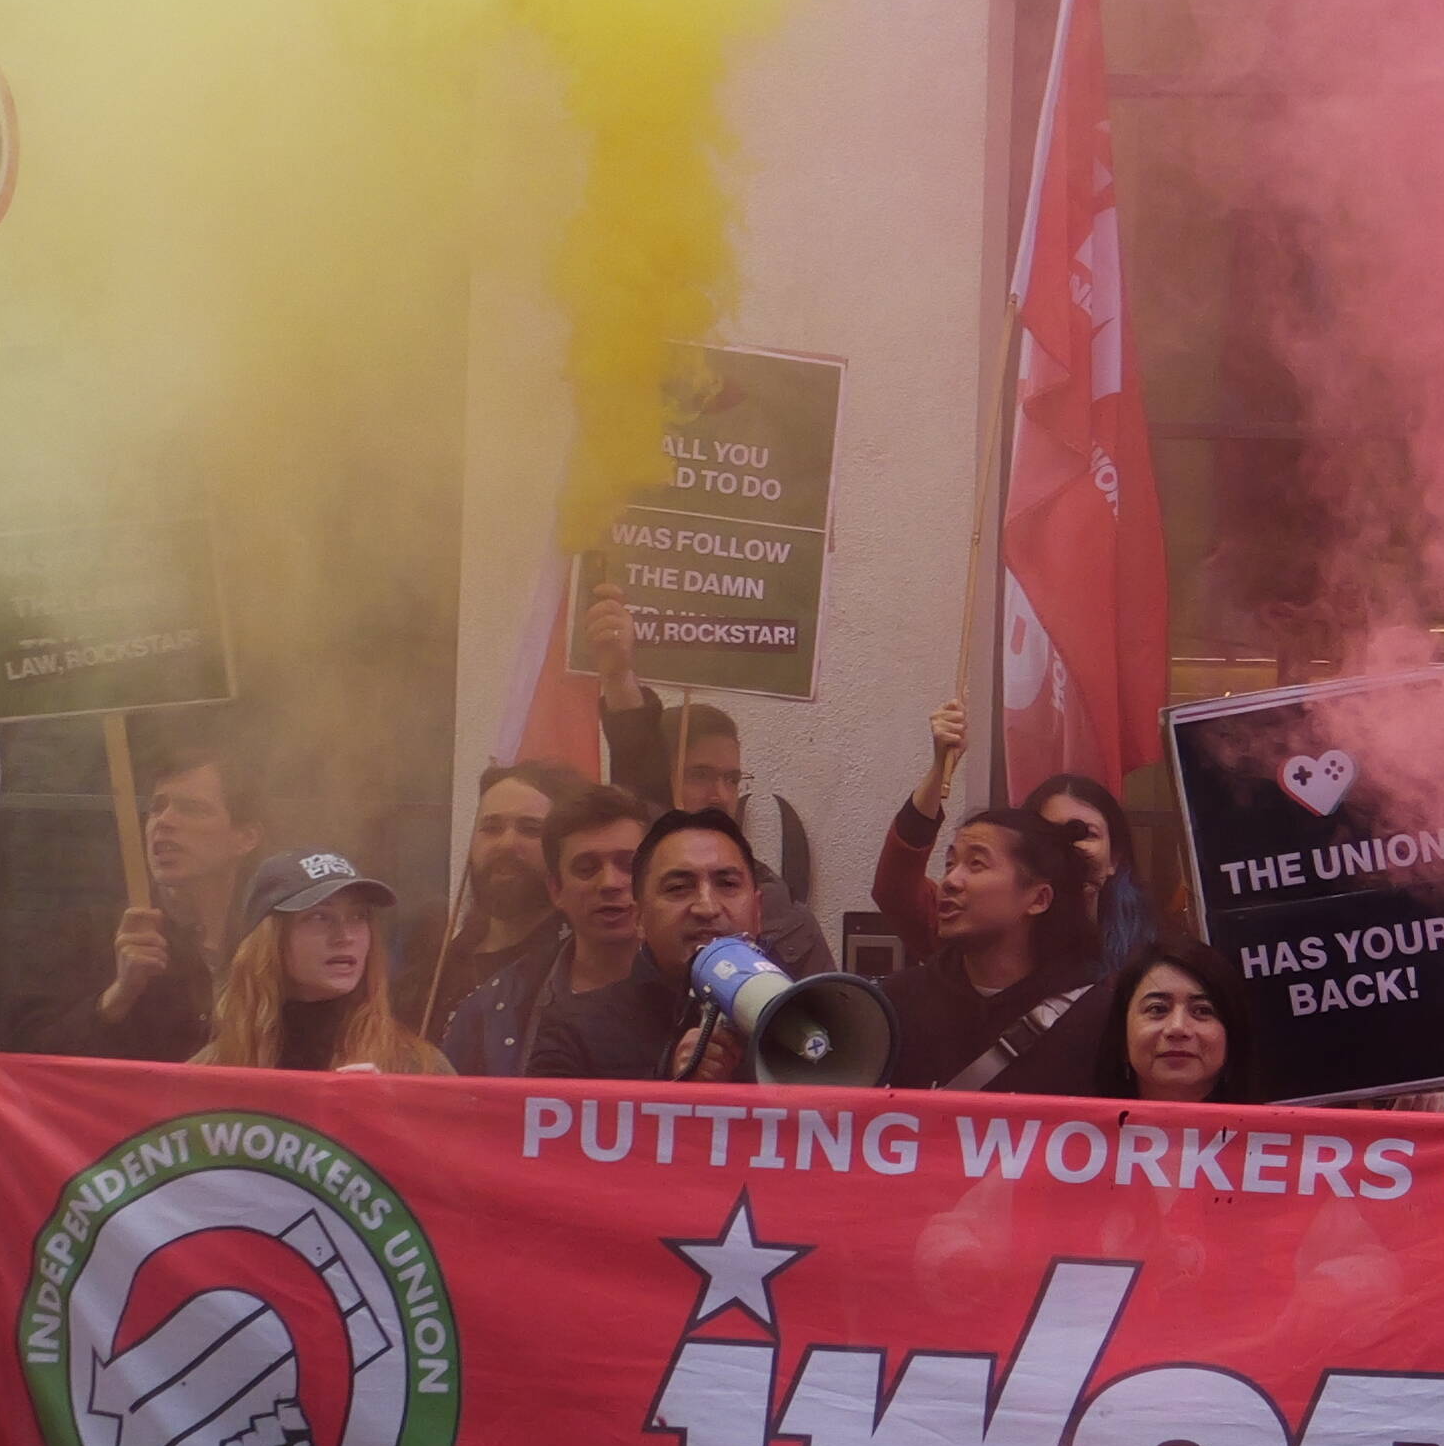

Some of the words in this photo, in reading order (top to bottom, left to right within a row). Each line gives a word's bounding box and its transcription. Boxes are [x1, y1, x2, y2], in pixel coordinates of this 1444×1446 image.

[714, 441, 769, 469] YOU
[701, 469, 737, 494] TO
[743, 476, 782, 501] DO
[612, 523, 672, 551] WAS
[676, 530, 792, 564] FOLLOW
[626, 563, 680, 591] THE
[683, 569, 765, 601] DAMN
[664, 621, 797, 646] ROCKSTAR!
[1219, 853, 1306, 897] THE
[1239, 935, 1328, 980] HAS
[1288, 965, 1421, 1019] BACK!
[521, 1096, 921, 1175] PUTTING
[956, 1115, 1414, 1201] WORKERS
[26, 1129, 193, 1366] INDEPENDENT
[200, 1121, 394, 1229] WORKERS
[382, 1232, 451, 1397] UNION
